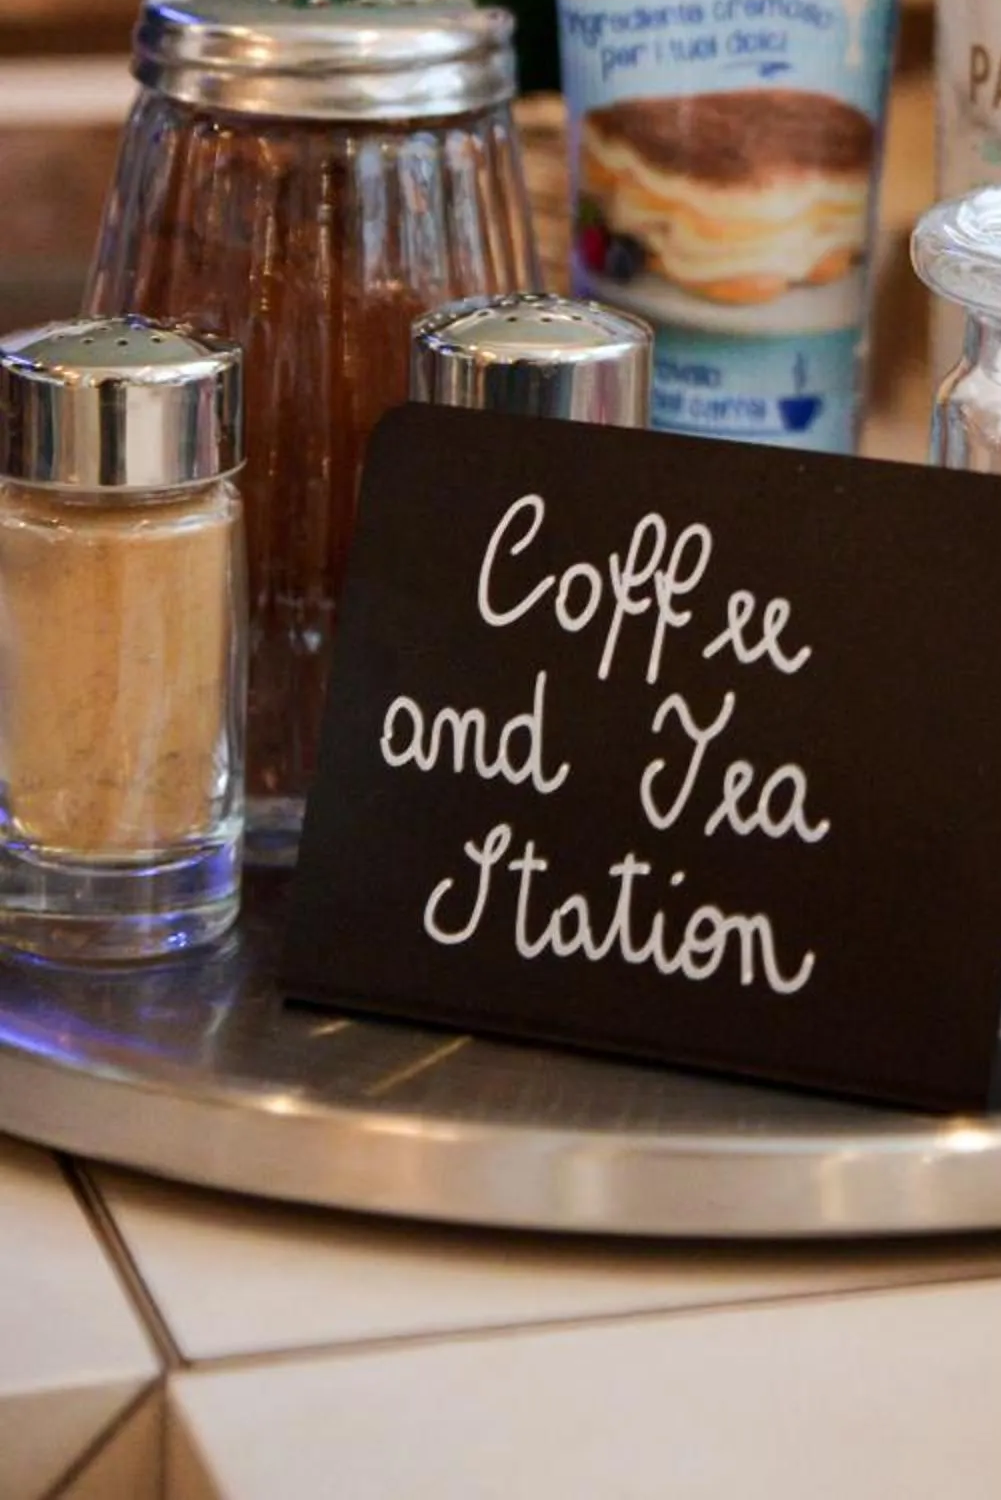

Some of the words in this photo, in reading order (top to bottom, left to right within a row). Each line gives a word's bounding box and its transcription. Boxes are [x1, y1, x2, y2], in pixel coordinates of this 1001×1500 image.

[477, 493, 812, 684] Coffee
[379, 669, 571, 794] and
[638, 690, 831, 843] Tea
[422, 822, 816, 995] Station
